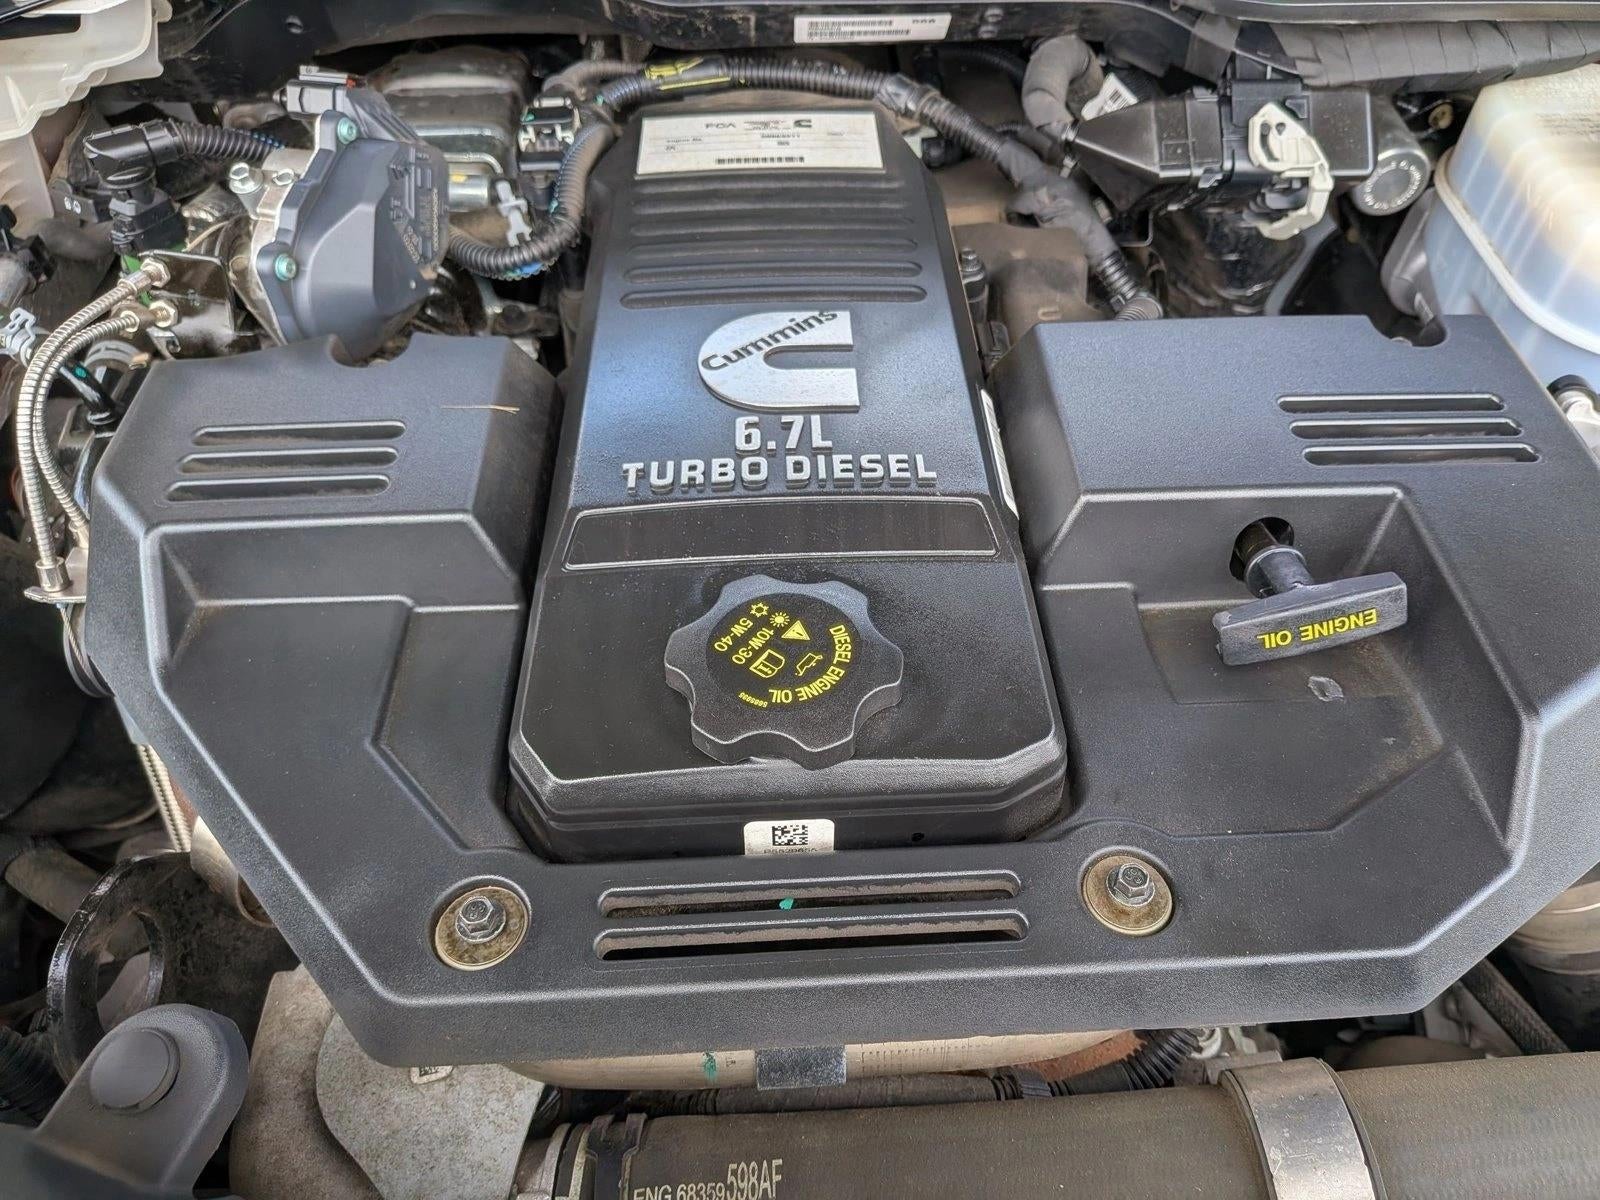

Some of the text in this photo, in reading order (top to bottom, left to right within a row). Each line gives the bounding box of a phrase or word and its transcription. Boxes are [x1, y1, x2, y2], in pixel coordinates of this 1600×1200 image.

[701, 309, 838, 370] Cummins
[735, 415, 833, 452] 6.7L
[622, 454, 937, 490] TURBO DIESEL
[714, 617, 754, 652] 5W-40
[731, 627, 775, 665] 10W-30
[829, 624, 852, 664] DIESEL
[1257, 608, 1378, 649] ENGINE OIL
[768, 688, 793, 704] OIL
[795, 665, 845, 702] ENGINE
[633, 1184, 672, 1200] ENG
